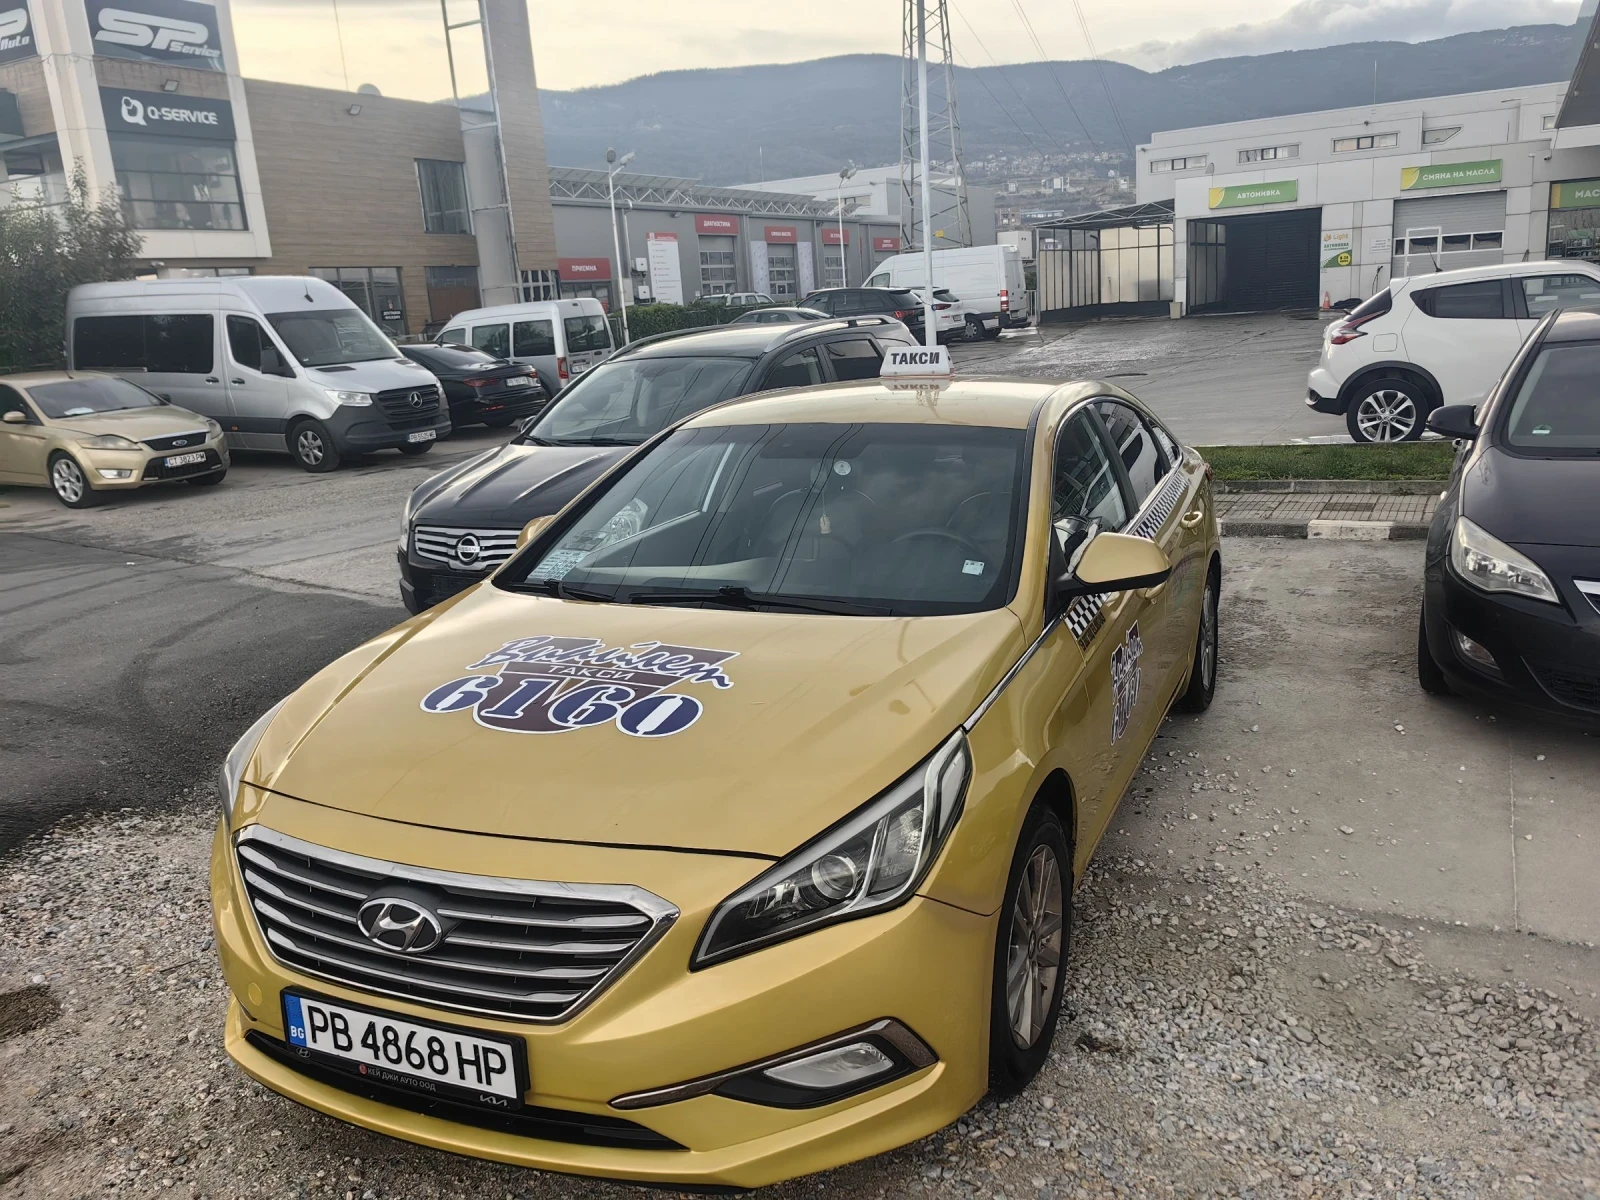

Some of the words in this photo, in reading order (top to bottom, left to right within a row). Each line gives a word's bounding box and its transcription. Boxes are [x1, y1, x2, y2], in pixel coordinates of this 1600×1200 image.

[94, 8, 209, 50] SP
[169, 41, 220, 57] Service
[1422, 173, 1451, 181] СМЯНА
[1466, 168, 1495, 177] МАСЛА
[1236, 189, 1281, 199] АВТОМИВКА
[891, 352, 940, 365] ТАКСИ
[547, 666, 635, 681] ТАКСИ
[420, 674, 704, 737] 6160
[290, 1025, 305, 1039] BG
[361, 1020, 449, 1075] 4868
[382, 1071, 399, 1082] ДЖИ
[400, 1075, 418, 1086] АУТО
[419, 1080, 437, 1092] ООД
